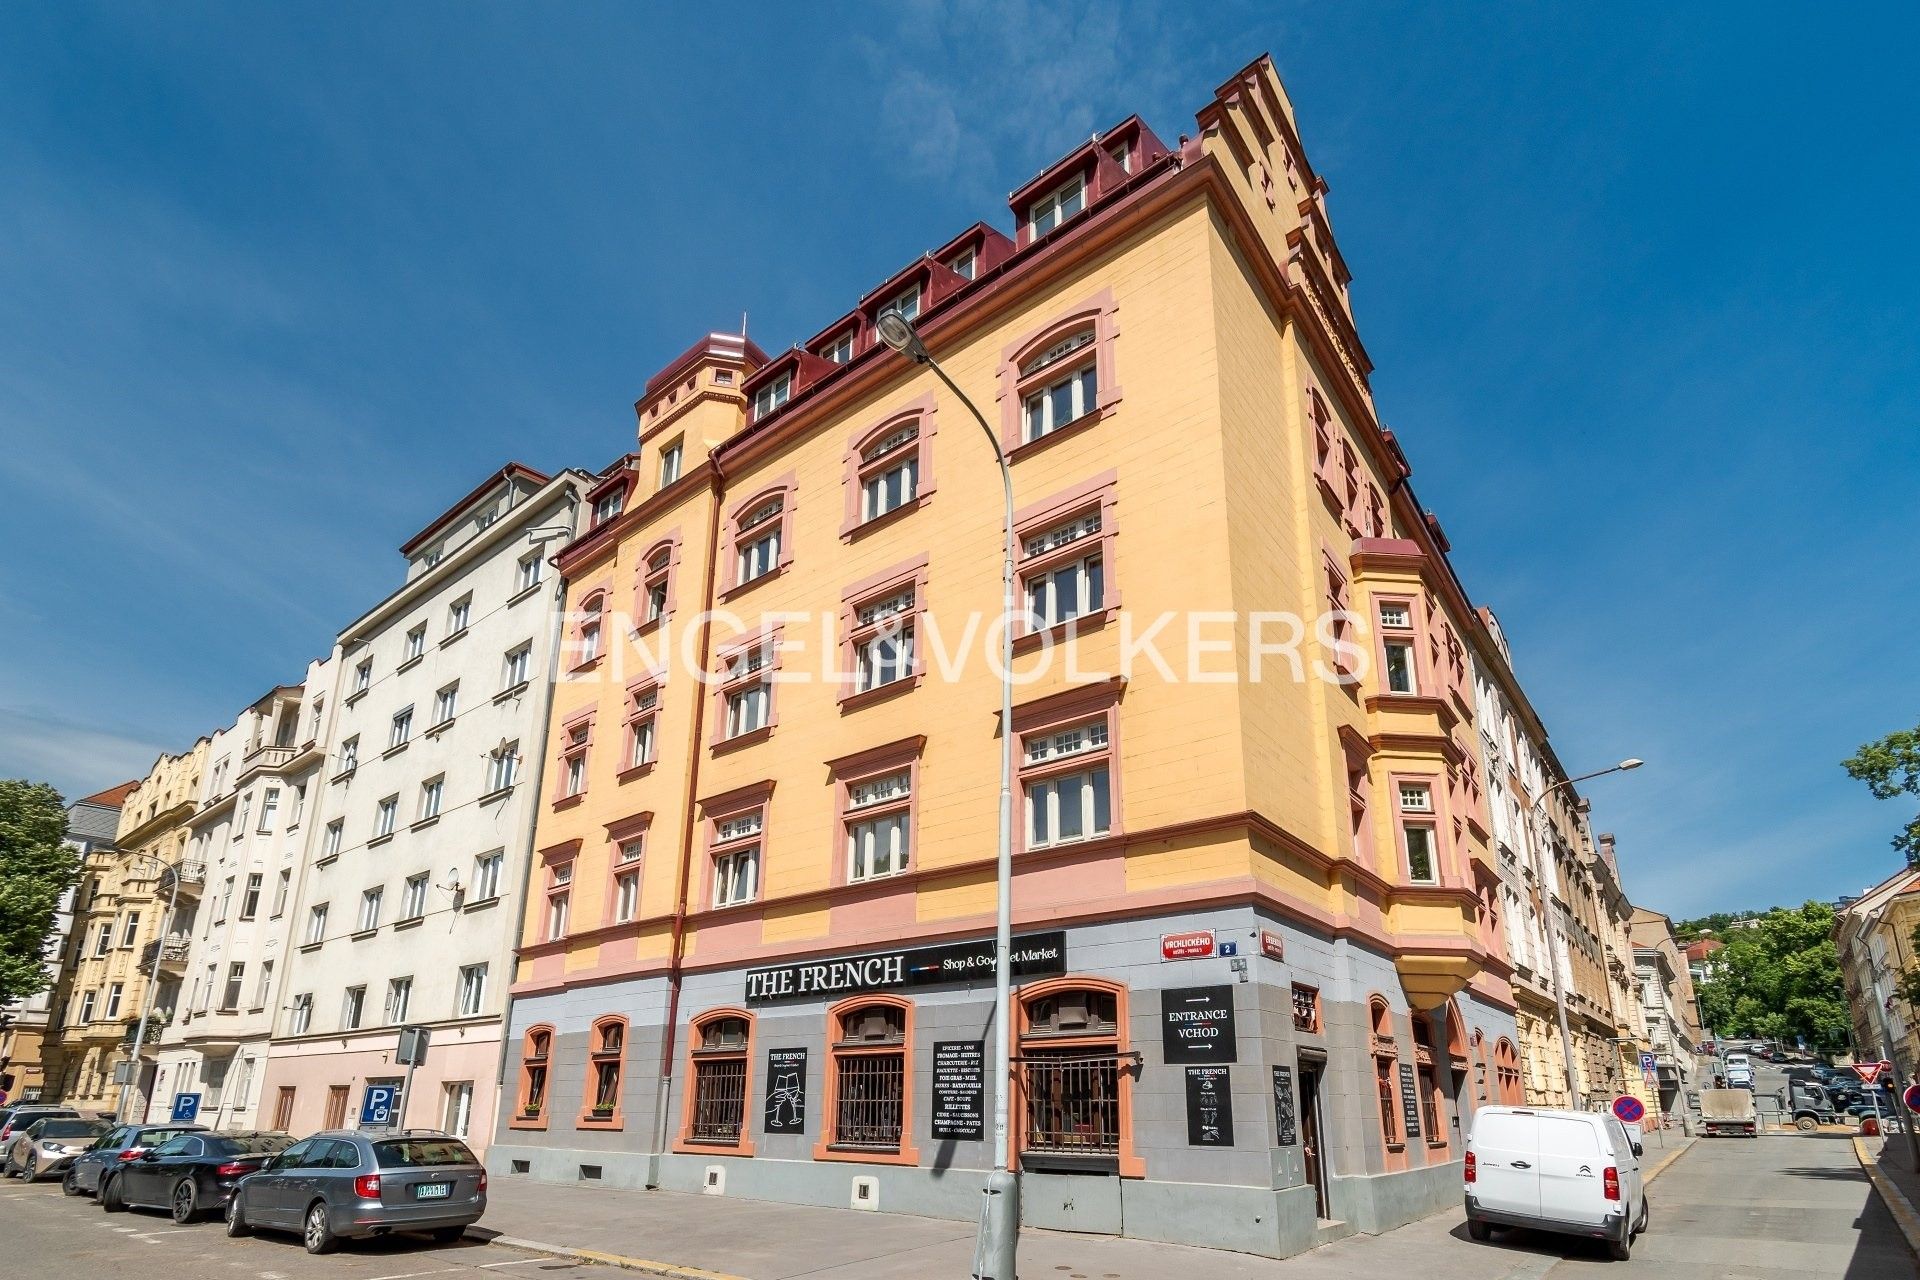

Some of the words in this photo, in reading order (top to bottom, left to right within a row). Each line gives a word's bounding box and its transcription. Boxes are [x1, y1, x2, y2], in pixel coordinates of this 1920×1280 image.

[1165, 937, 1210, 949] VRCHLICKÉHO
[1224, 945, 1231, 953] 2
[747, 969, 793, 997] THE
[798, 956, 904, 992] FRENCH
[943, 958, 966, 971] Shop
[966, 956, 975, 968] &
[1021, 947, 1058, 962] Market
[1168, 1010, 1228, 1022] ENTRANCE
[1178, 1027, 1219, 1039] VCHOD
[770, 1053, 782, 1061] THE
[782, 1052, 806, 1060] FRENCH
[178, 1096, 195, 1112] P
[369, 1089, 389, 1110] P
